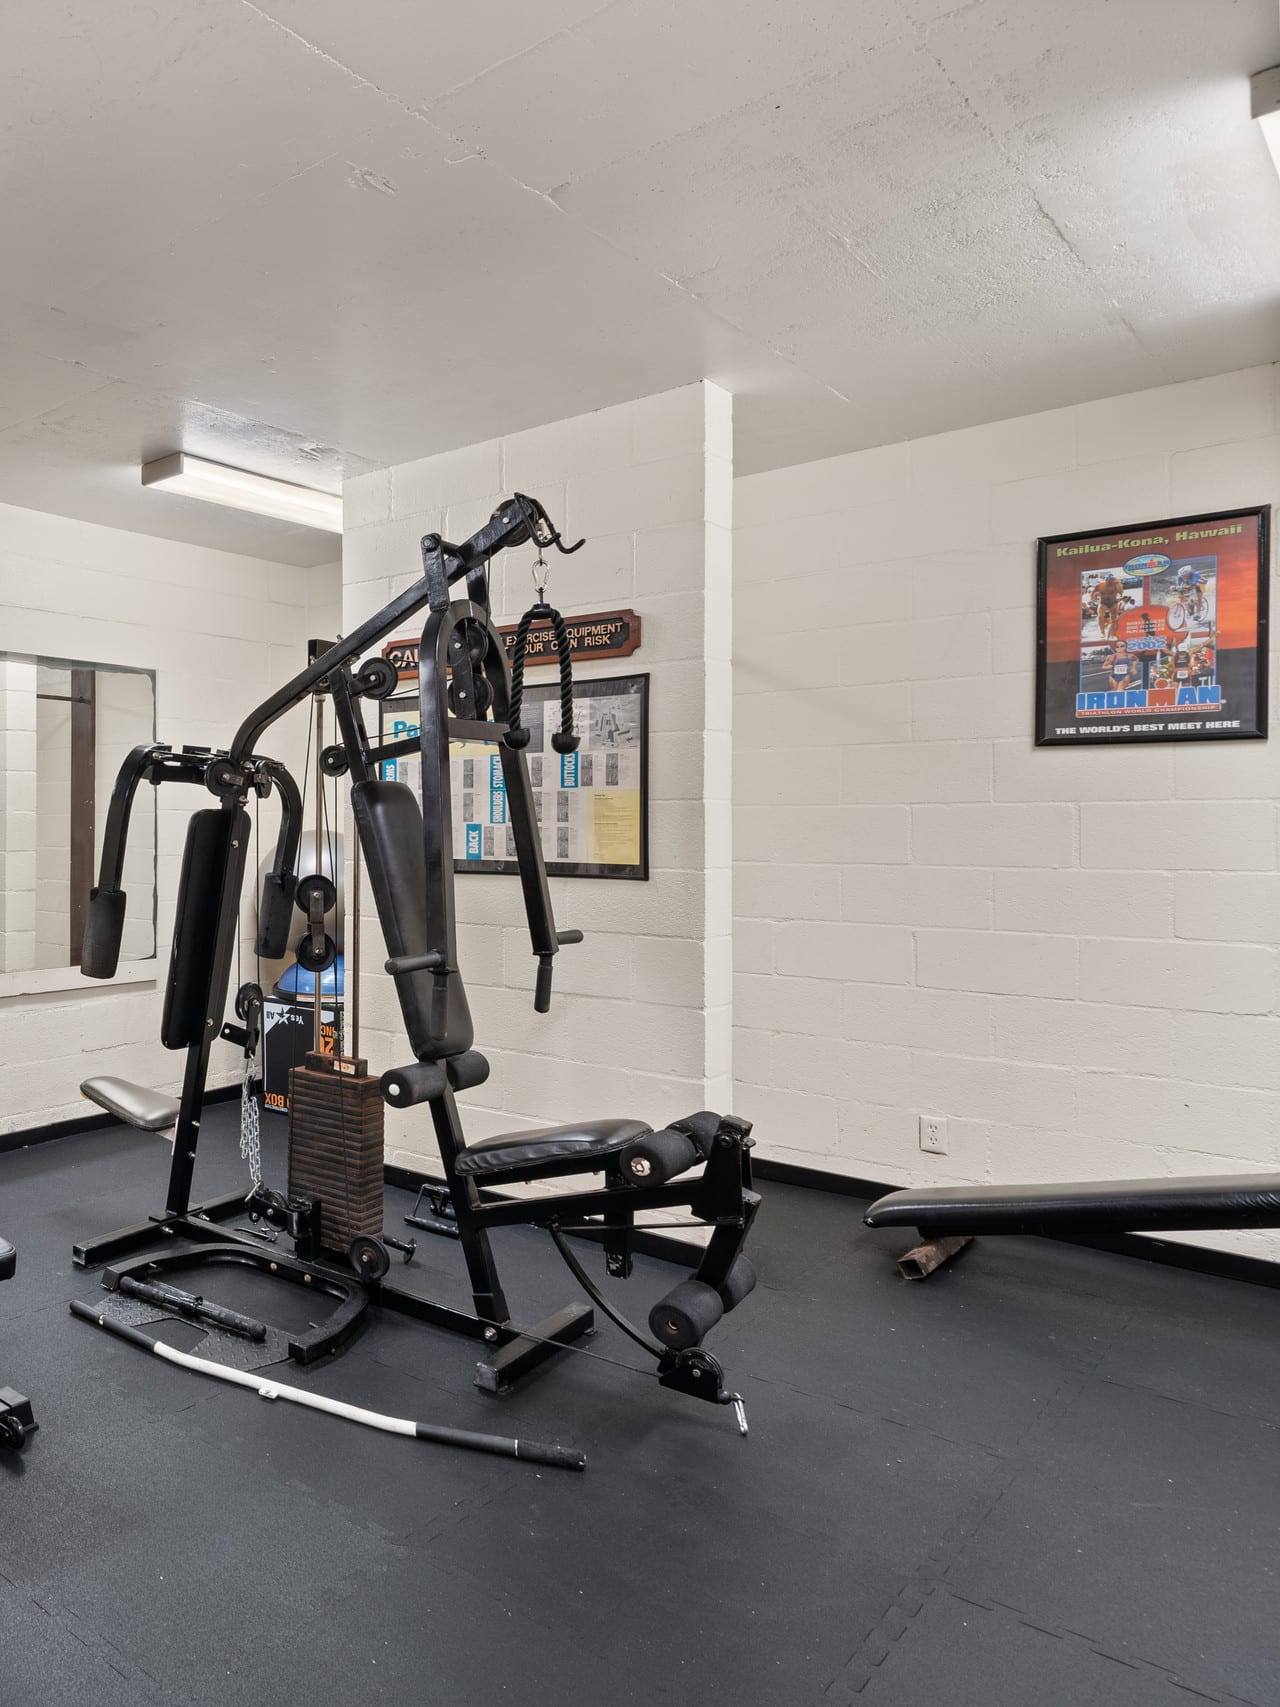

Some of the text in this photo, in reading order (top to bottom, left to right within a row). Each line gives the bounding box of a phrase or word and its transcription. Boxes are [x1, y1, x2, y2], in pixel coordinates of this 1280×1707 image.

[1056, 524, 1243, 557] Kailua-Kona, Hawaii
[566, 623, 623, 638] QUIPMENT
[584, 634, 611, 647] RISK
[1127, 639, 1166, 651] 2002
[1077, 683, 1221, 711] IRONMAN
[1124, 707, 1151, 715] WORLD
[1154, 705, 1217, 713] CHAMPIONSHIP
[1055, 720, 1240, 735] THE WORLD'S BEST MEET HERE
[385, 764, 395, 781] RMS
[492, 790, 504, 823] SHOULDERS
[468, 830, 479, 854] BACK
[264, 1092, 285, 1108] BOX
